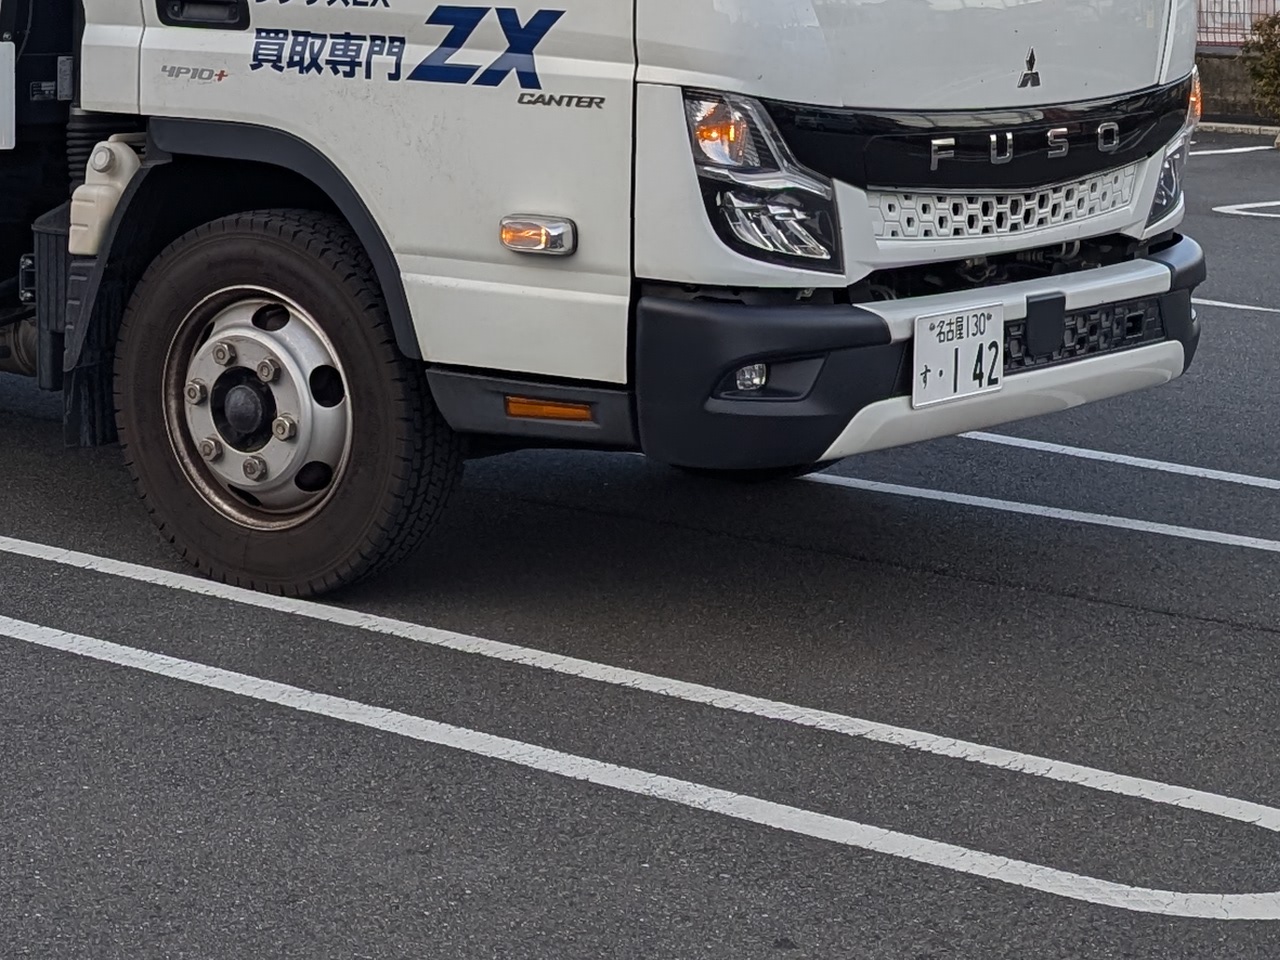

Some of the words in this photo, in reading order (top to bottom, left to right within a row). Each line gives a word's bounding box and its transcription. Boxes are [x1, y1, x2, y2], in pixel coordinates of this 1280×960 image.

[249, 28, 407, 82] 買取専門
[406, 4, 567, 90] ZX
[517, 93, 606, 110] CANTER
[929, 121, 1120, 171] FUSO
